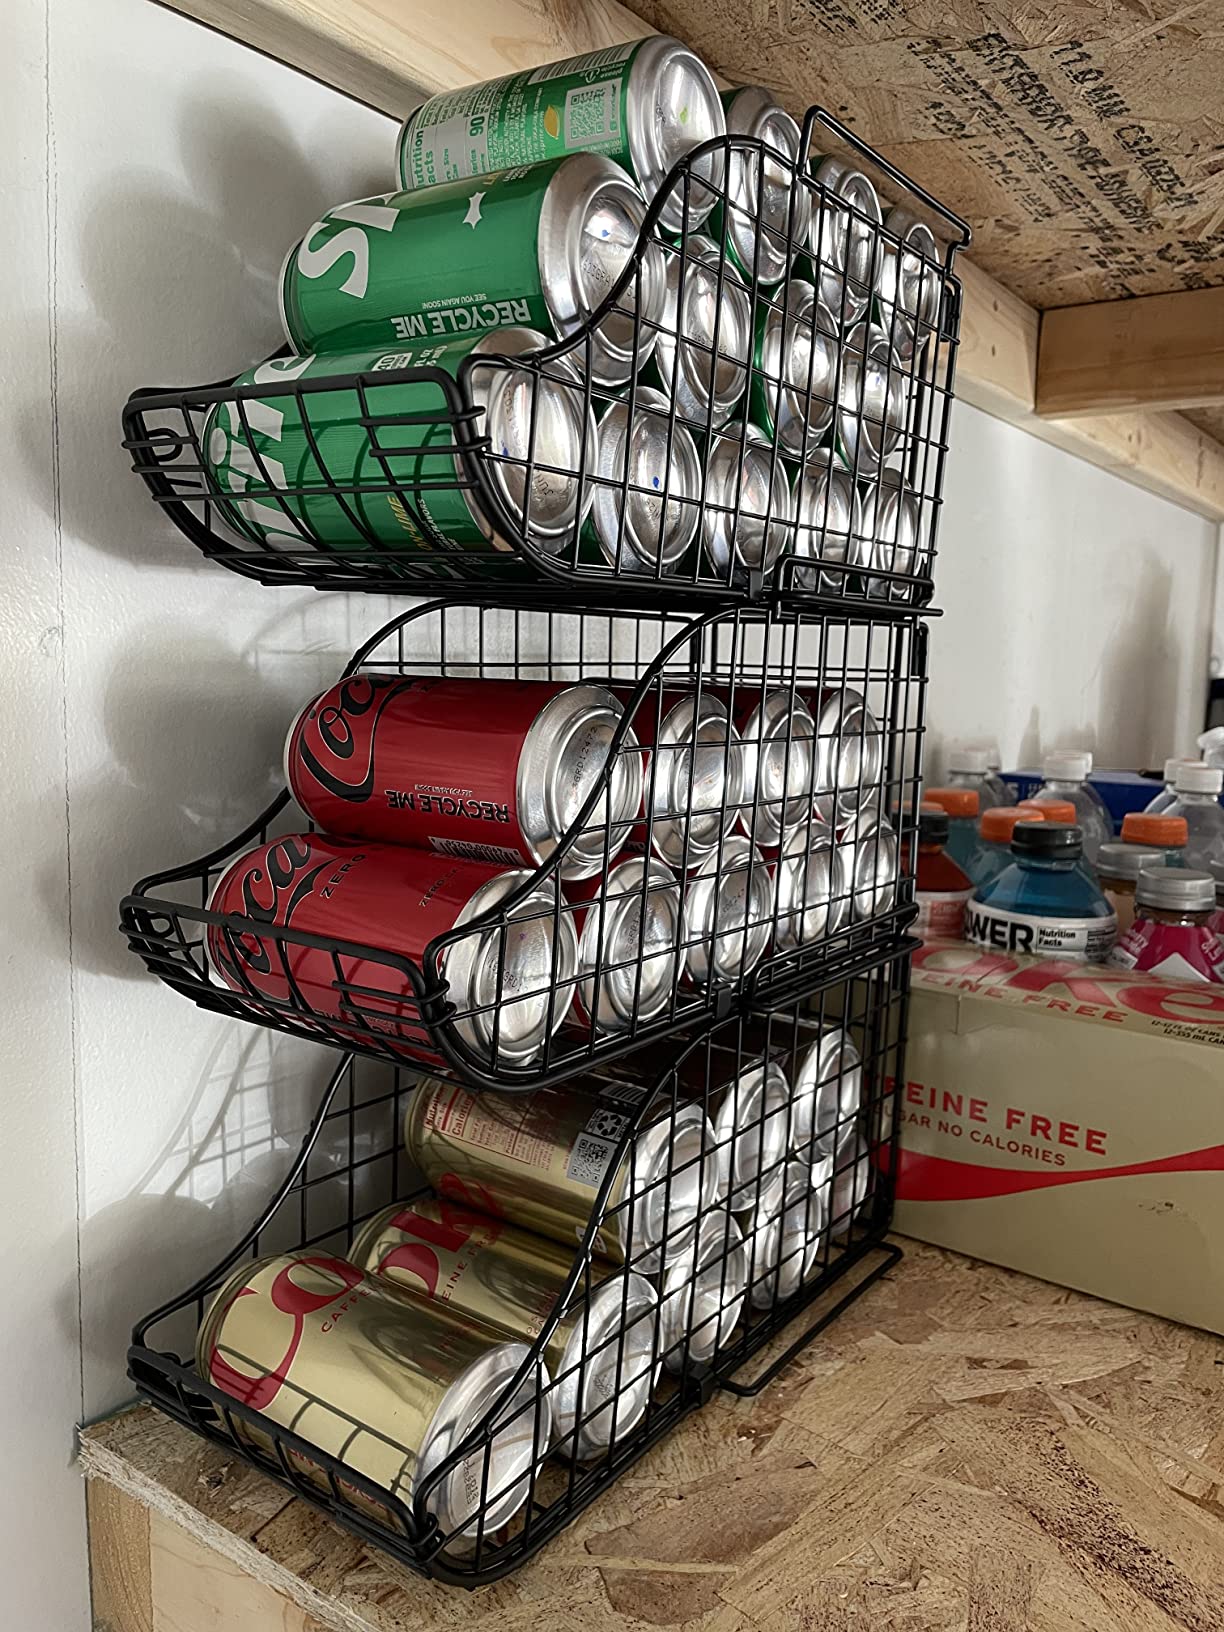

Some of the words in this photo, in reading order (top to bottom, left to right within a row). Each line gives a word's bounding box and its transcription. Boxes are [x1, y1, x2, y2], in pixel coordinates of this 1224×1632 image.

[469, 115, 486, 137] 90
[426, 150, 437, 184] acts
[390, 314, 427, 339] ME
[427, 299, 532, 334] RECYCLE
[384, 789, 415, 810] ME
[417, 792, 511, 824] RECYCLE
[319, 851, 366, 900] ZERO
[1039, 928, 1076, 938] Nutrition
[1022, 994, 1128, 1023] FREE
[937, 1119, 963, 1138] NO
[969, 1129, 1067, 1168] CALORIES
[1005, 1108, 1109, 1156] FREE
